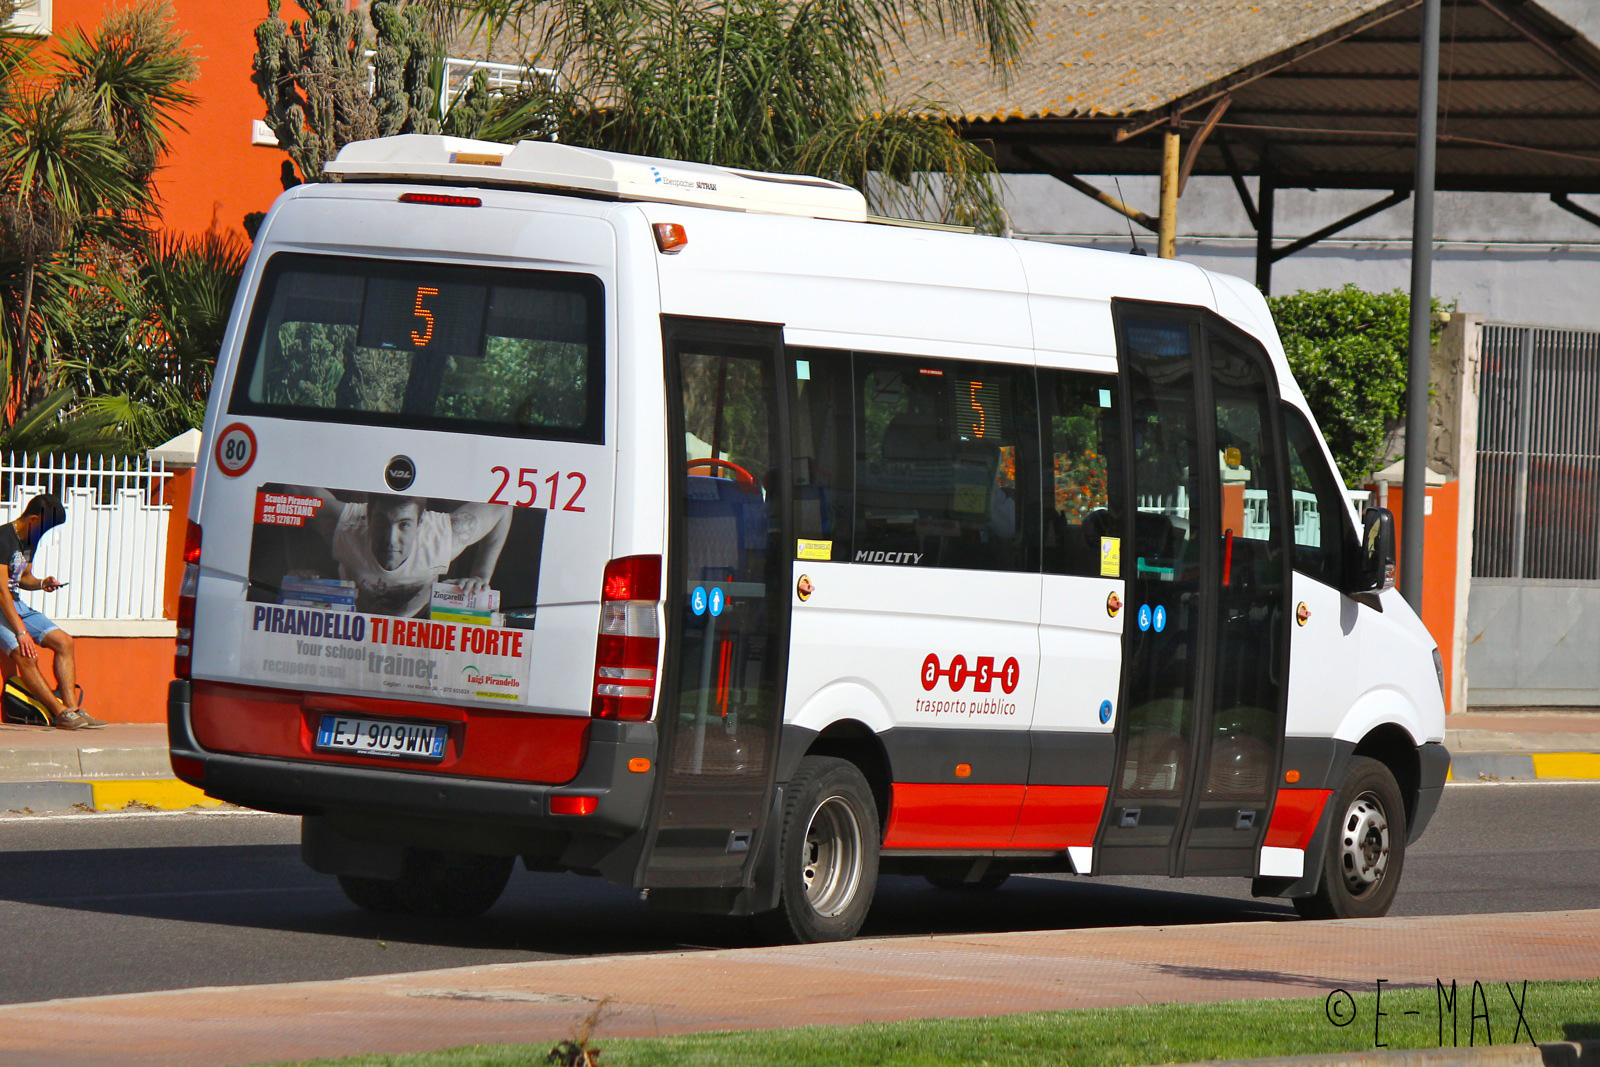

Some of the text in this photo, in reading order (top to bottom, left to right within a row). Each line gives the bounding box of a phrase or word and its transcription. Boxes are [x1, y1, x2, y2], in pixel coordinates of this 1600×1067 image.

[411, 286, 439, 347] 5
[970, 381, 985, 438] 5
[225, 438, 246, 461] 80
[488, 465, 587, 513] 2512
[263, 505, 275, 514] per
[265, 493, 321, 507] Scuola Pirandello
[855, 550, 924, 564] MIDCITY
[433, 590, 464, 602] Zingarelli
[252, 605, 524, 658] PIRANDELLO TI RENDE FORTE
[297, 639, 366, 661] Your school
[263, 659, 317, 677] recupero
[368, 651, 438, 680] trainer.
[467, 674, 520, 688] Luigi Pirandello
[915, 698, 1016, 718] trasporto pubblico
